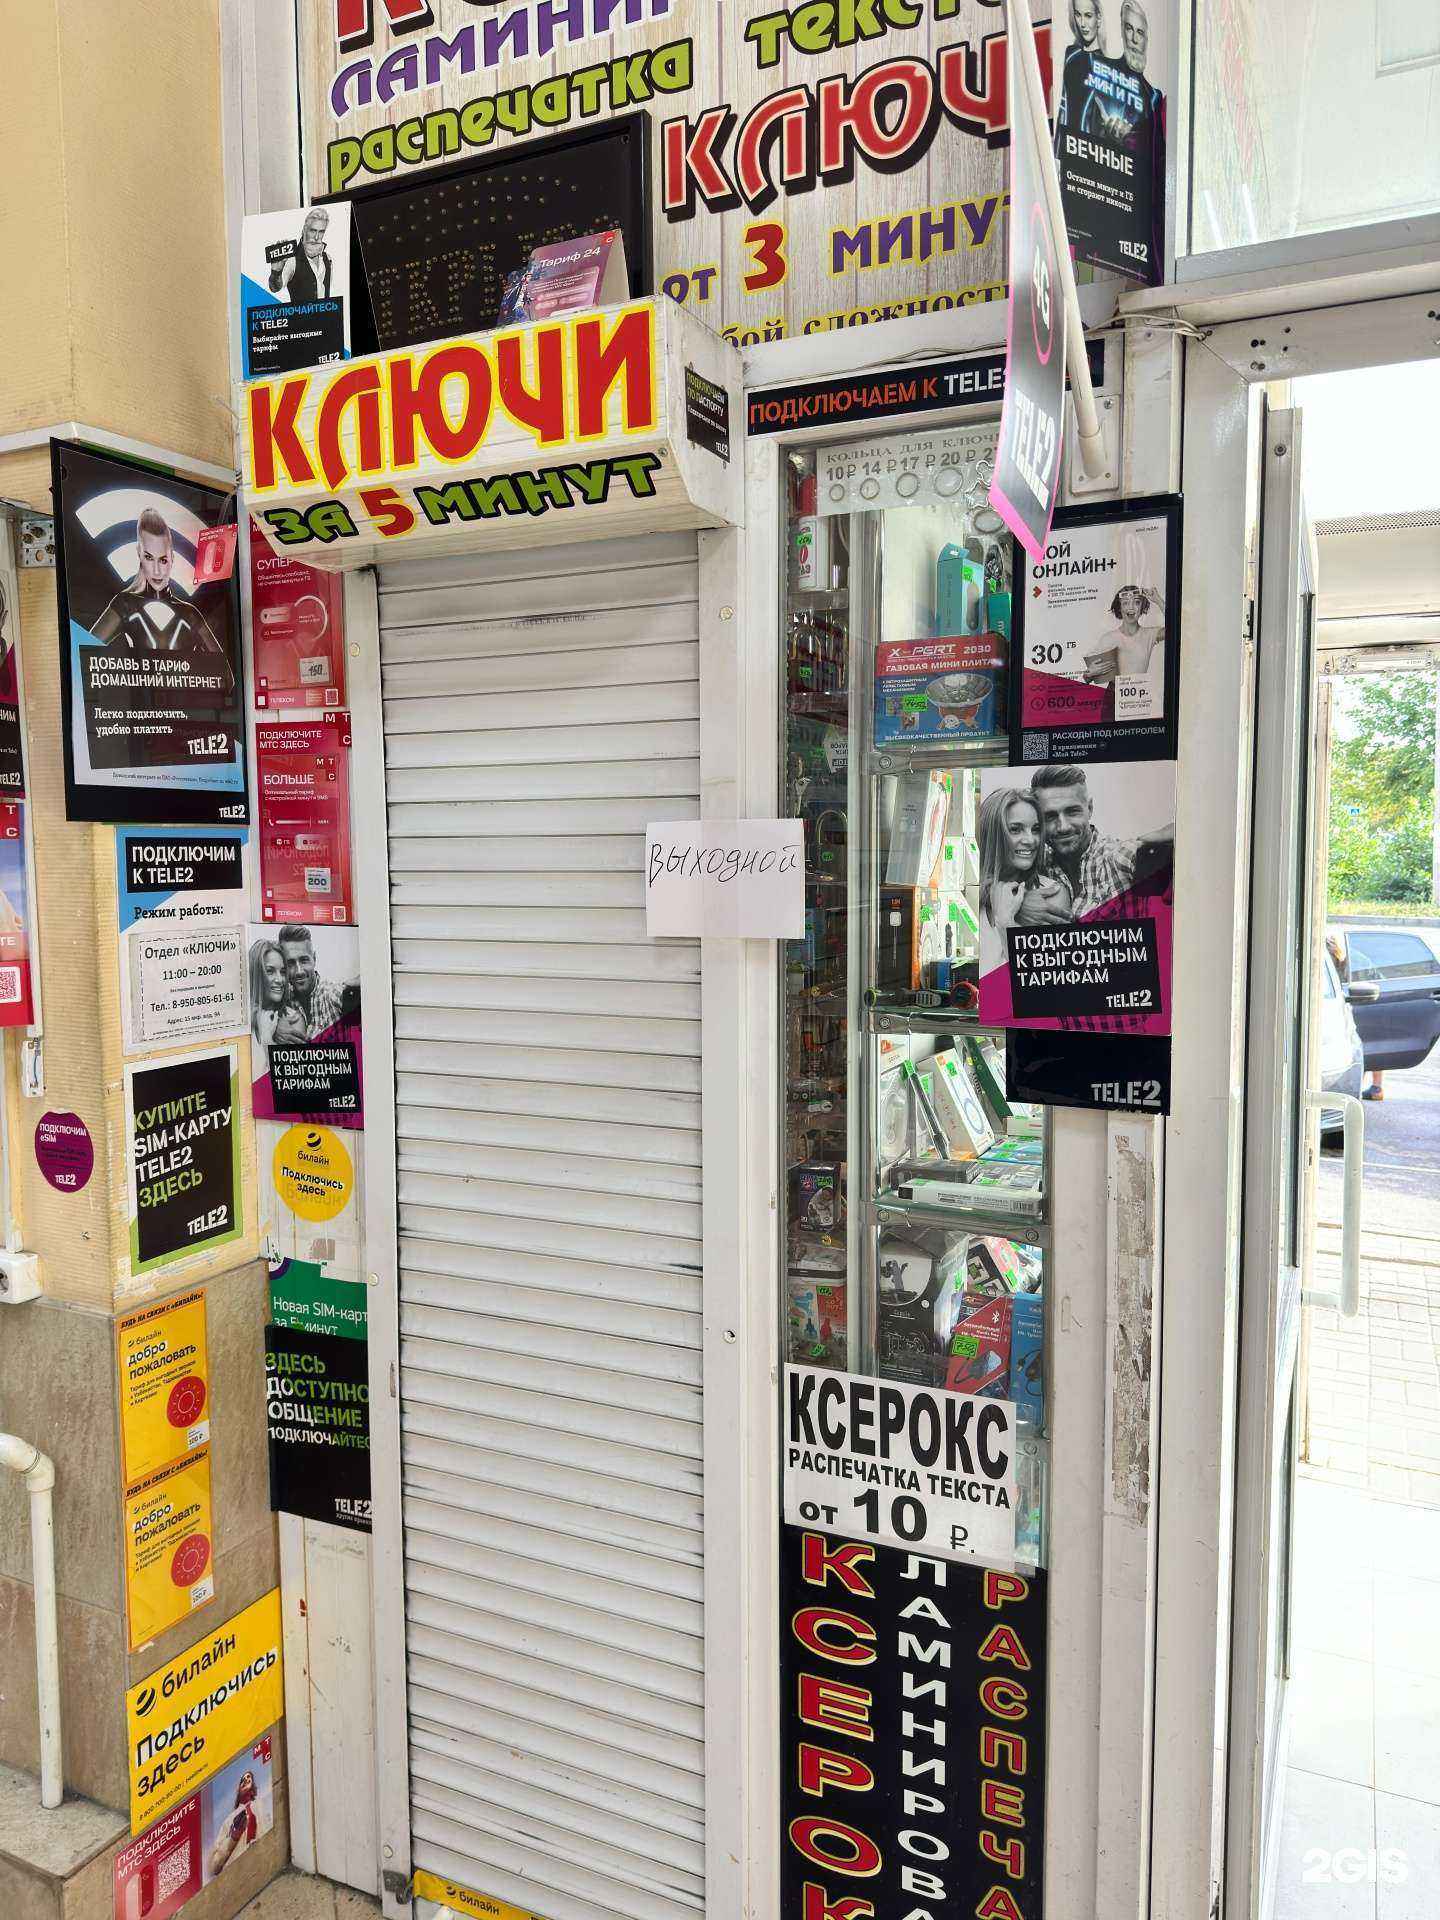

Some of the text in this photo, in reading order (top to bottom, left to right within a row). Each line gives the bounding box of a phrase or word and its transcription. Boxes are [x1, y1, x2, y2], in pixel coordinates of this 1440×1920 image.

[1092, 59, 1140, 94] ВЕЧНЫЕ
[1085, 73, 1114, 97] МИН
[1126, 91, 1144, 111] ГБ
[662, 20, 1053, 222] КЛЮЧ
[1066, 134, 1135, 177] ВЕЧНЫЕ
[1066, 170, 1096, 189] Остатки
[1096, 180, 1119, 196] минут
[1125, 189, 1134, 201] ГБ
[1067, 184, 1133, 213] не сгорают никогда
[269, 243, 294, 259] TELE2
[743, 222, 788, 291] 3
[832, 196, 1011, 274] МИНУ
[1119, 239, 1148, 263] TELE2
[540, 246, 601, 270] Тариф 24
[252, 300, 339, 321] ПОДКЛЮЧАЙТЕСЬ
[252, 318, 289, 331] К TELE2
[252, 330, 323, 344] Выбирайте выгодные
[252, 344, 279, 354] тарифы
[318, 351, 341, 365] TELE2
[248, 306, 656, 491] КЛЮЧИ
[749, 379, 918, 425] ПОДКЛЮЧАЕМ
[923, 377, 939, 400] К
[943, 367, 1008, 396] TELE
[826, 447, 893, 463] КОЛЬЦА
[900, 440, 934, 455] ДЛЯ
[1010, 388, 1056, 512] TELE2
[826, 451, 961, 481] 10 14 17 20
[263, 452, 662, 544] ЗА 5 МИНУТ
[1042, 541, 1071, 560] ОЙ
[1032, 557, 1117, 580] ОНЛАЙН+
[963, 645, 992, 655] 2030
[1031, 641, 1077, 666] 30 ГБ
[89, 656, 191, 673] ДОБАВЬ В ТАРИФ
[885, 658, 994, 672] ГАЗОВАЯ МИНИ ПЛИТА
[90, 670, 223, 689] ДОМАШНИЙ ИНТЕРНЕТ
[1119, 687, 1137, 697] 100
[94, 708, 189, 721] Легко подключить,
[95, 723, 173, 738] удобно платить
[259, 730, 322, 740] ПОДКЛЮЧИТЕ
[1052, 726, 1166, 741] РАСХОДЫ ПОД КОНТРОЛЕМ
[187, 733, 229, 756] TELE2
[259, 740, 310, 749] МТС ЗДЕСЬ
[264, 774, 315, 785] БОЛЬШЕ
[219, 804, 246, 819] TELE2
[132, 845, 236, 866] ПОДКЛЮЧИМ
[133, 867, 194, 884] К TELE2
[307, 878, 328, 886] 200
[134, 903, 224, 920] Режим работы:
[144, 940, 237, 960] Отдел «КЛЮЧИ»
[1014, 928, 1144, 951] ПОДКЛЮЧИМ
[1016, 947, 1148, 969] К ВЫГОДНЫМ
[163, 964, 222, 981] 11:00 20:00
[1017, 968, 1110, 987] ТАРИФАМ
[150, 993, 235, 1013] Тел.: 8-950-805-61-61
[1106, 989, 1153, 1008] TELE2
[272, 1048, 350, 1065] ПОДКЛЮЧИМ
[274, 1063, 352, 1077] К ВЫГОДНЫМ
[275, 1077, 331, 1090] ТАРИФАМ
[1091, 1080, 1162, 1106] TELE2
[134, 1091, 207, 1132] КУПИТЕ
[328, 1094, 356, 1109] TELE2
[40, 1123, 87, 1137] ПОДКЛЮЧИМ
[134, 1106, 233, 1158] SIM-КАРТУ
[136, 1145, 194, 1183] TELE2
[297, 1150, 330, 1166] билайн
[55, 1174, 77, 1186] TELE2
[138, 1168, 204, 1209] ЗДЕСЬ
[281, 1166, 344, 1190] Подключись
[296, 1183, 326, 1197] здесь
[187, 1204, 228, 1237] TELE2
[273, 1296, 310, 1315] Новая
[128, 1341, 167, 1368] добро
[129, 1343, 197, 1381] пожаловать
[265, 1352, 326, 1375] ЗДЕСЬ
[266, 1376, 369, 1404] ДОСТУПНО
[268, 1400, 363, 1428] ОБЩЕНИЕ
[789, 1372, 1009, 1480] КСЕРОКС
[788, 1448, 1011, 1510] РАСПЕЧАТКА ТЕКСТА
[133, 1503, 172, 1534] добро
[335, 1498, 372, 1519] TELE2
[853, 1488, 928, 1542] 10
[134, 1503, 201, 1547] пожаловать
[161, 1634, 236, 1699] билайн
[136, 1651, 277, 1768] Подключись
[137, 1735, 206, 1799] здесь
[117, 1799, 196, 1868] ПОДКЛЮЧИТЕ
[117, 1825, 181, 1880] МТС ЗДЕСЬ
[458, 1891, 500, 1915] билайн
